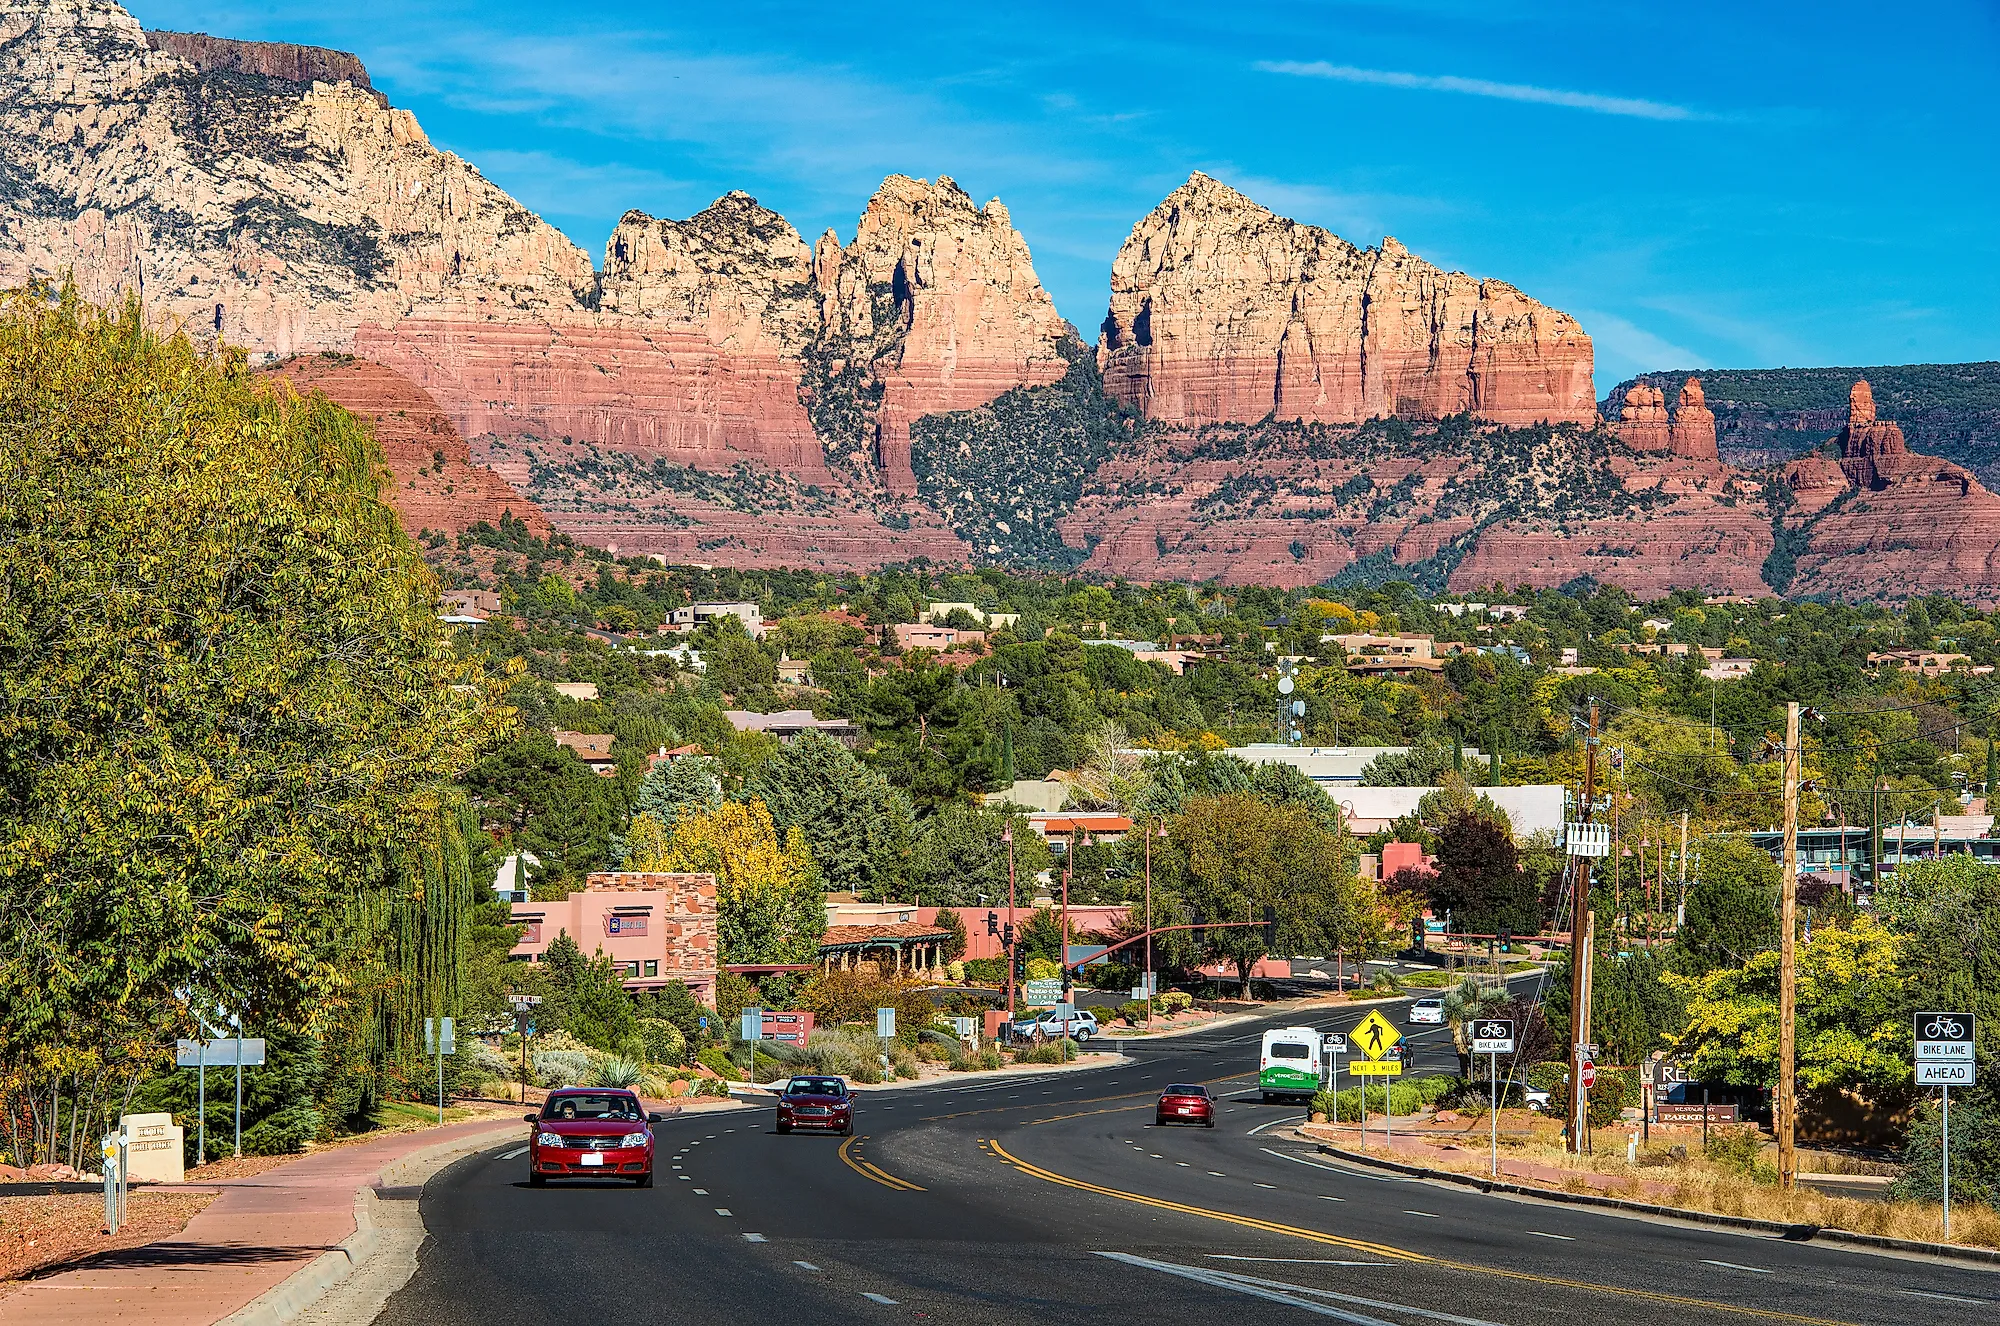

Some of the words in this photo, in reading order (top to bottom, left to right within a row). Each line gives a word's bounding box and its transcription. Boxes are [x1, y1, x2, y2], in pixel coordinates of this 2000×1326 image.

[1478, 1041, 1491, 1049] BIKE
[1493, 1041, 1508, 1049] LANE
[1923, 1045, 1942, 1055] BIKE
[1944, 1045, 1966, 1055] LANE
[1582, 1069, 1594, 1080] STOP
[1924, 1067, 1966, 1079] AHEAD
